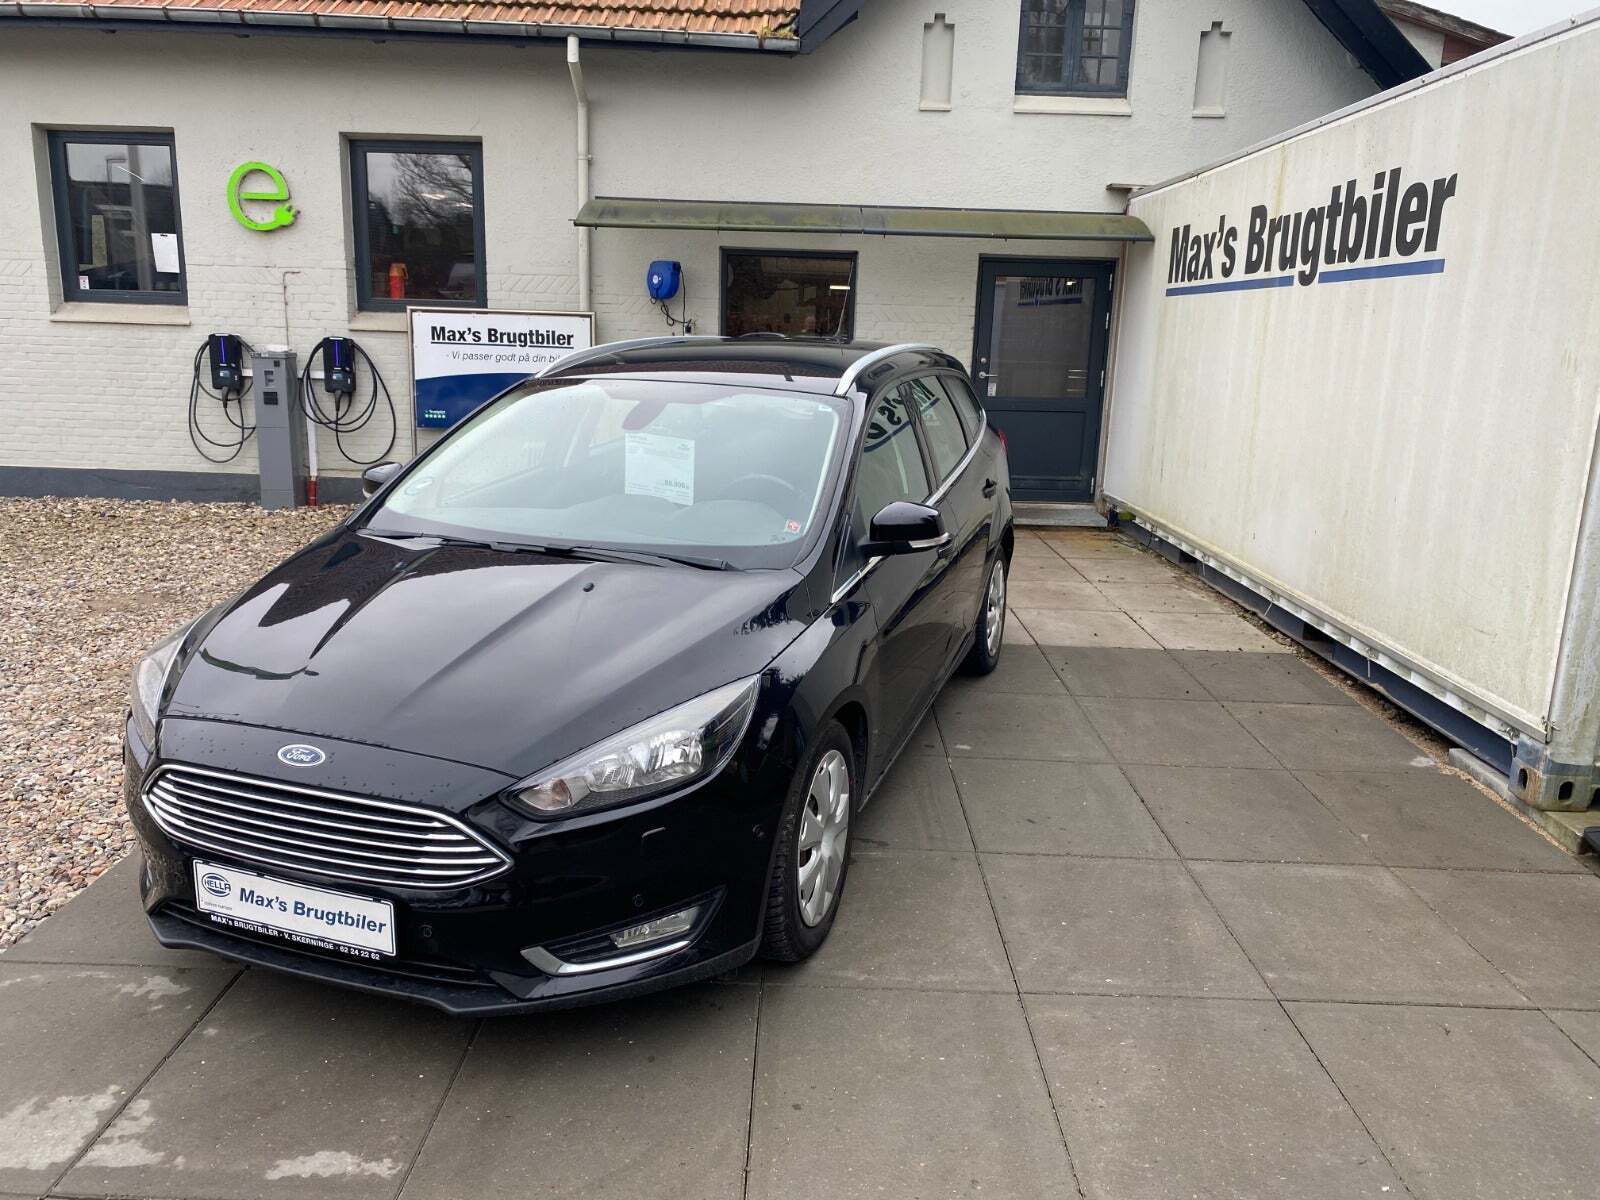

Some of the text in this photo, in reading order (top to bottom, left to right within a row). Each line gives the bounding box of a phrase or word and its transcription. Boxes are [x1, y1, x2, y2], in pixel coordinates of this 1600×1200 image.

[1167, 167, 1458, 286] Max's Brugtbiler
[430, 326, 575, 348] Max's Brugtbiler
[452, 351, 460, 360] Vi
[463, 353, 494, 361] passer
[495, 352, 516, 362] godt
[518, 352, 530, 363] på
[531, 352, 547, 363] din
[286, 748, 316, 762] Ford
[240, 887, 387, 933] Max's Brugtbiler
[234, 920, 279, 937] BRUGTBILER
[291, 935, 334, 949] SKERNINGE
[350, 947, 360, 956] 24
[360, 950, 370, 958] 22
